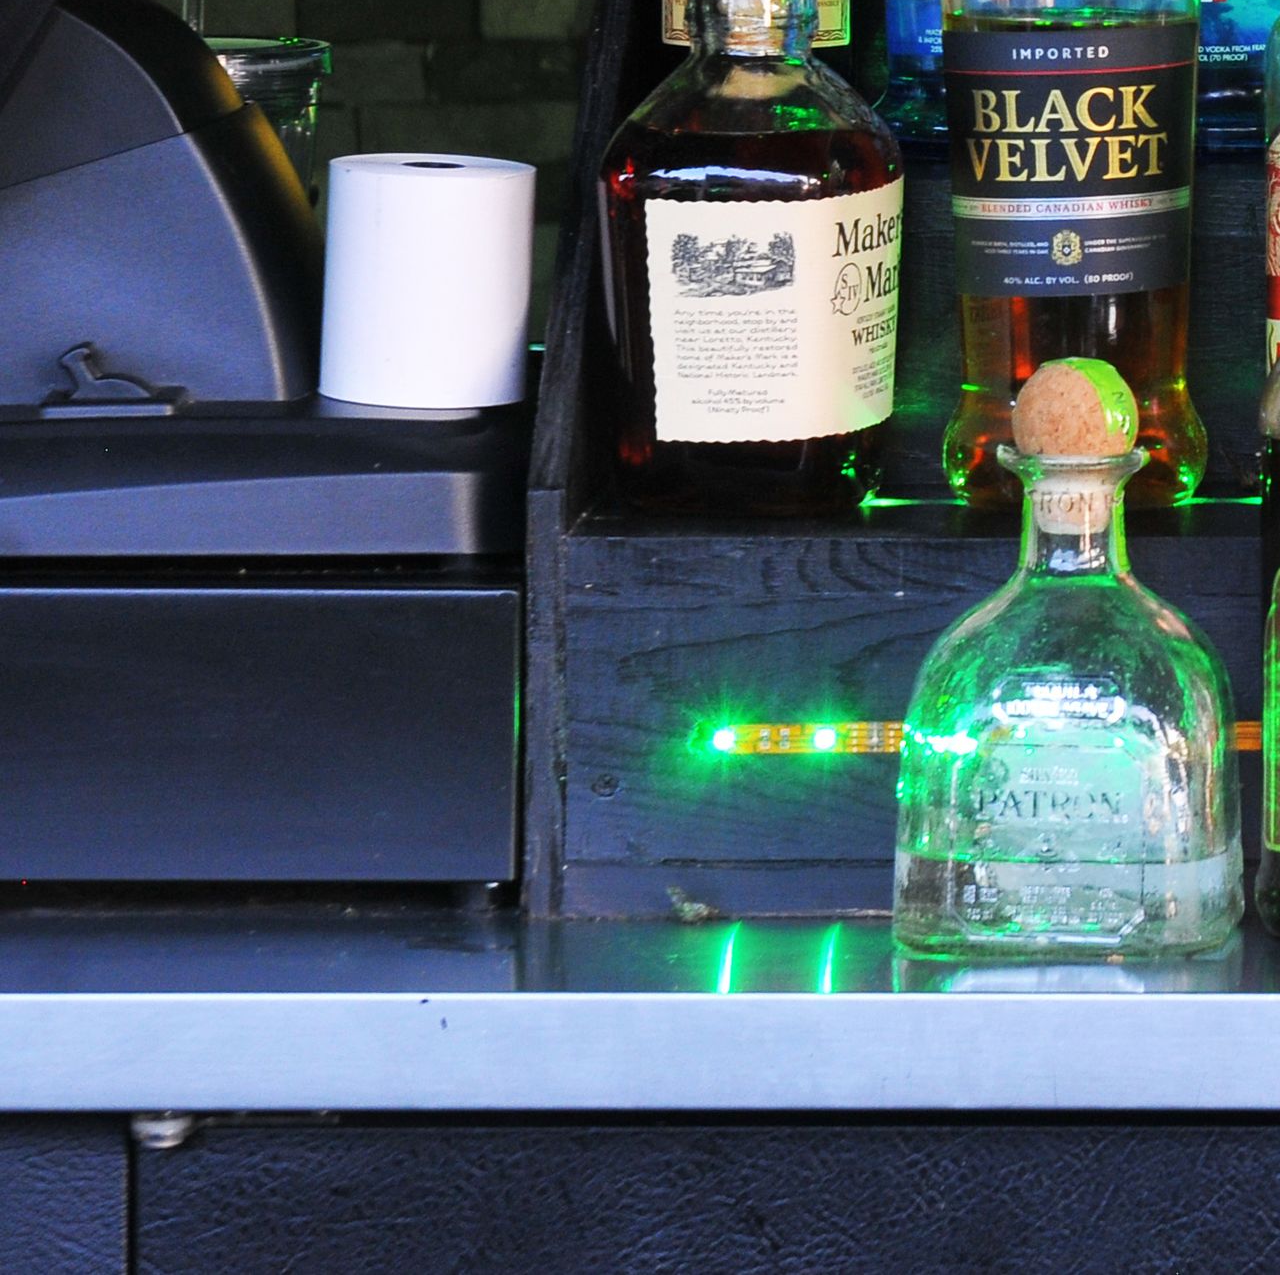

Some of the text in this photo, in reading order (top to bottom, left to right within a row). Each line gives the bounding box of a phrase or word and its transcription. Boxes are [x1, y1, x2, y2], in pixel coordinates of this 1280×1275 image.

[1012, 46, 1110, 60] IMPORTED
[972, 85, 1158, 133] BLACK
[966, 132, 1168, 182] VELVET
[981, 199, 1154, 214] BLENDED CANADIAN WHISKY
